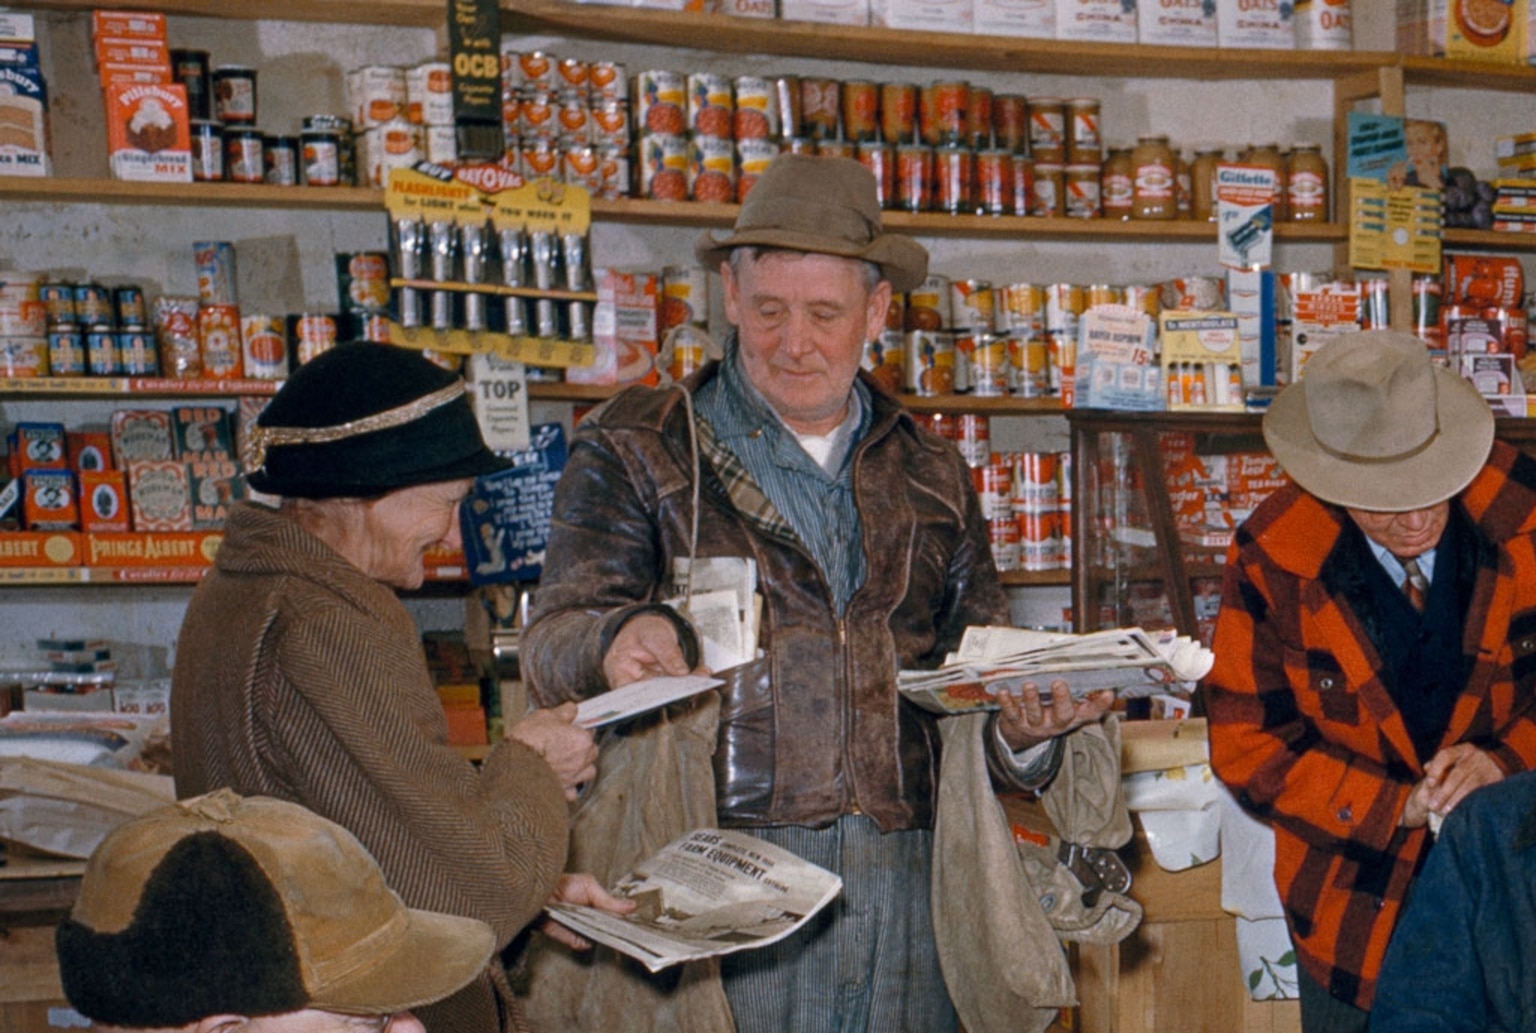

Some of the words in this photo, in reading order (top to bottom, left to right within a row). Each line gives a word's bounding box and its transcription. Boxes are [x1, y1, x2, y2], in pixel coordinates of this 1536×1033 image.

[455, 53, 499, 78] OCB
[119, 85, 184, 108] Pillsbury
[16, 154, 42, 166] MIX
[155, 163, 187, 175] MIX
[417, 161, 453, 180] BUY
[1219, 169, 1273, 187] Gillette
[420, 198, 454, 210] LIGHT
[479, 379, 522, 400] TOP
[178, 407, 222, 424] RED
[191, 462, 238, 479] RED
[89, 534, 143, 564] PRINCE
[145, 534, 196, 560] ALBERT
[690, 832, 722, 846] SEARS
[680, 841, 709, 856] FARM
[706, 848, 768, 881] EQUIPMENT
